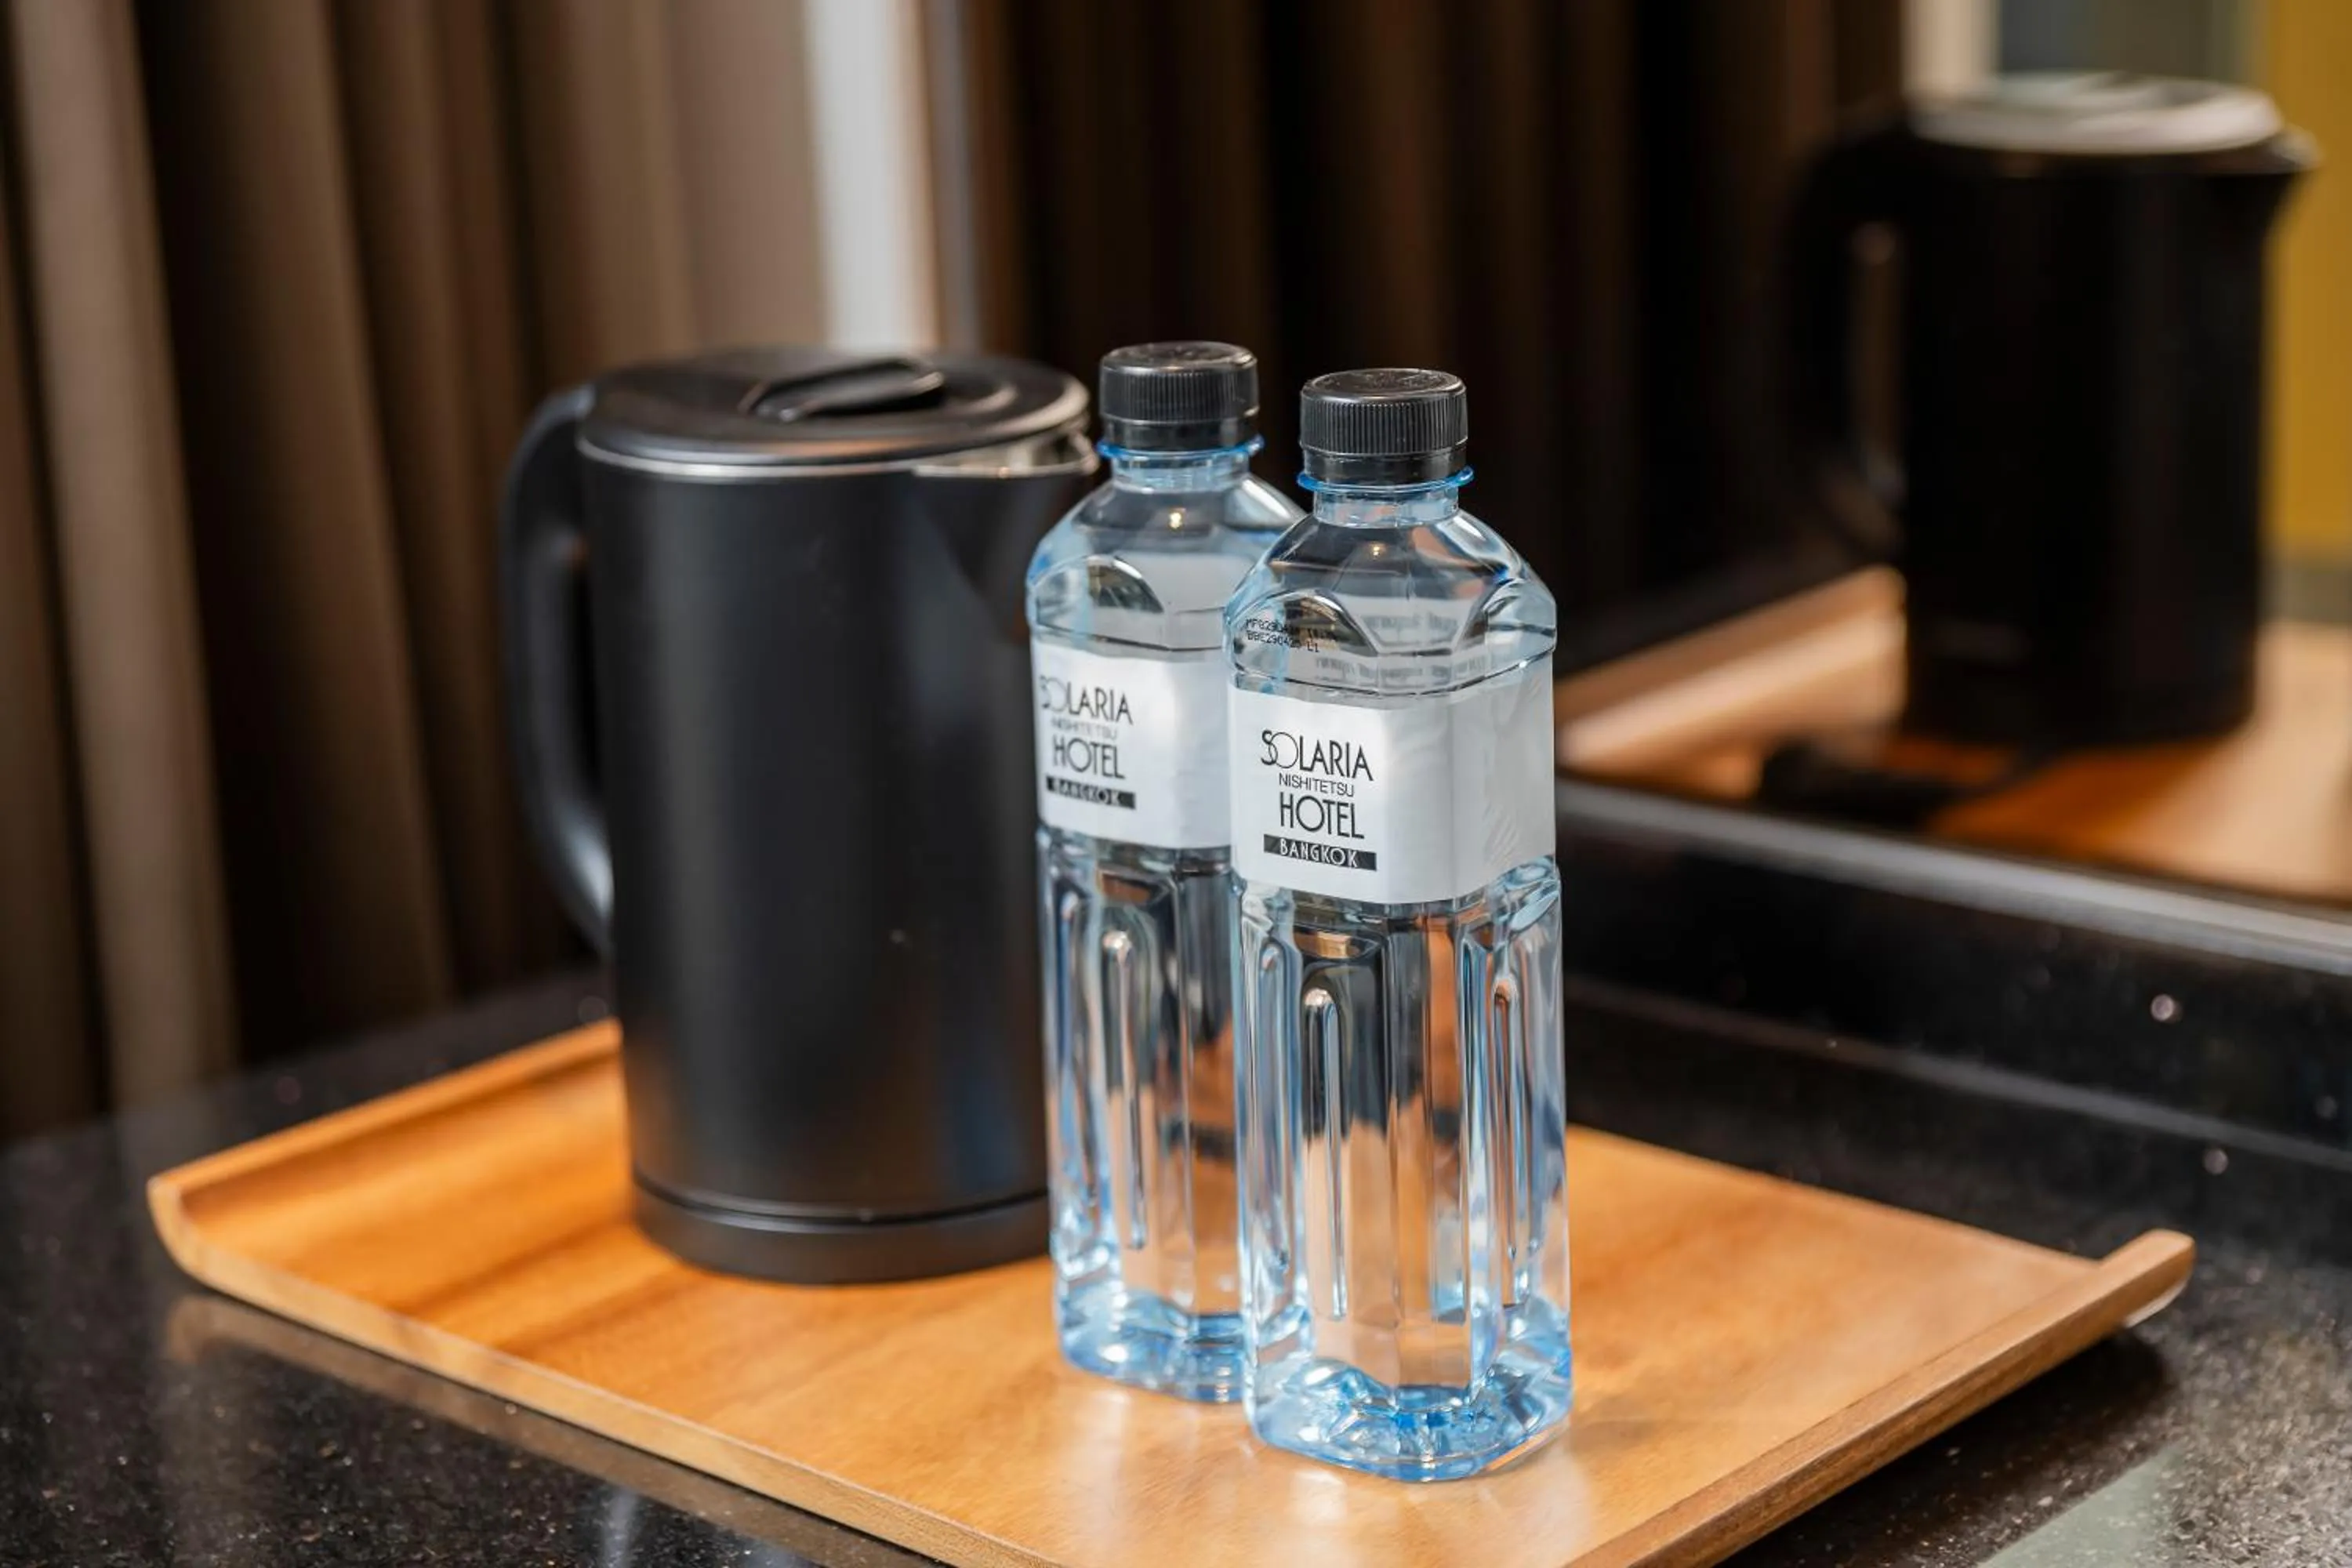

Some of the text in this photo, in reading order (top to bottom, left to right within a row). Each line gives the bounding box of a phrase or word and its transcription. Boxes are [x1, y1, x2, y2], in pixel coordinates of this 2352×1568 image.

[1039, 675, 1134, 725] SOLARIA
[1053, 734, 1126, 779] HOTEL
[1261, 729, 1374, 782] SOLARIA
[1279, 772, 1355, 797] NISHITETSU
[1279, 791, 1365, 840] HOTEL
[1279, 837, 1359, 868] BANGKOK
